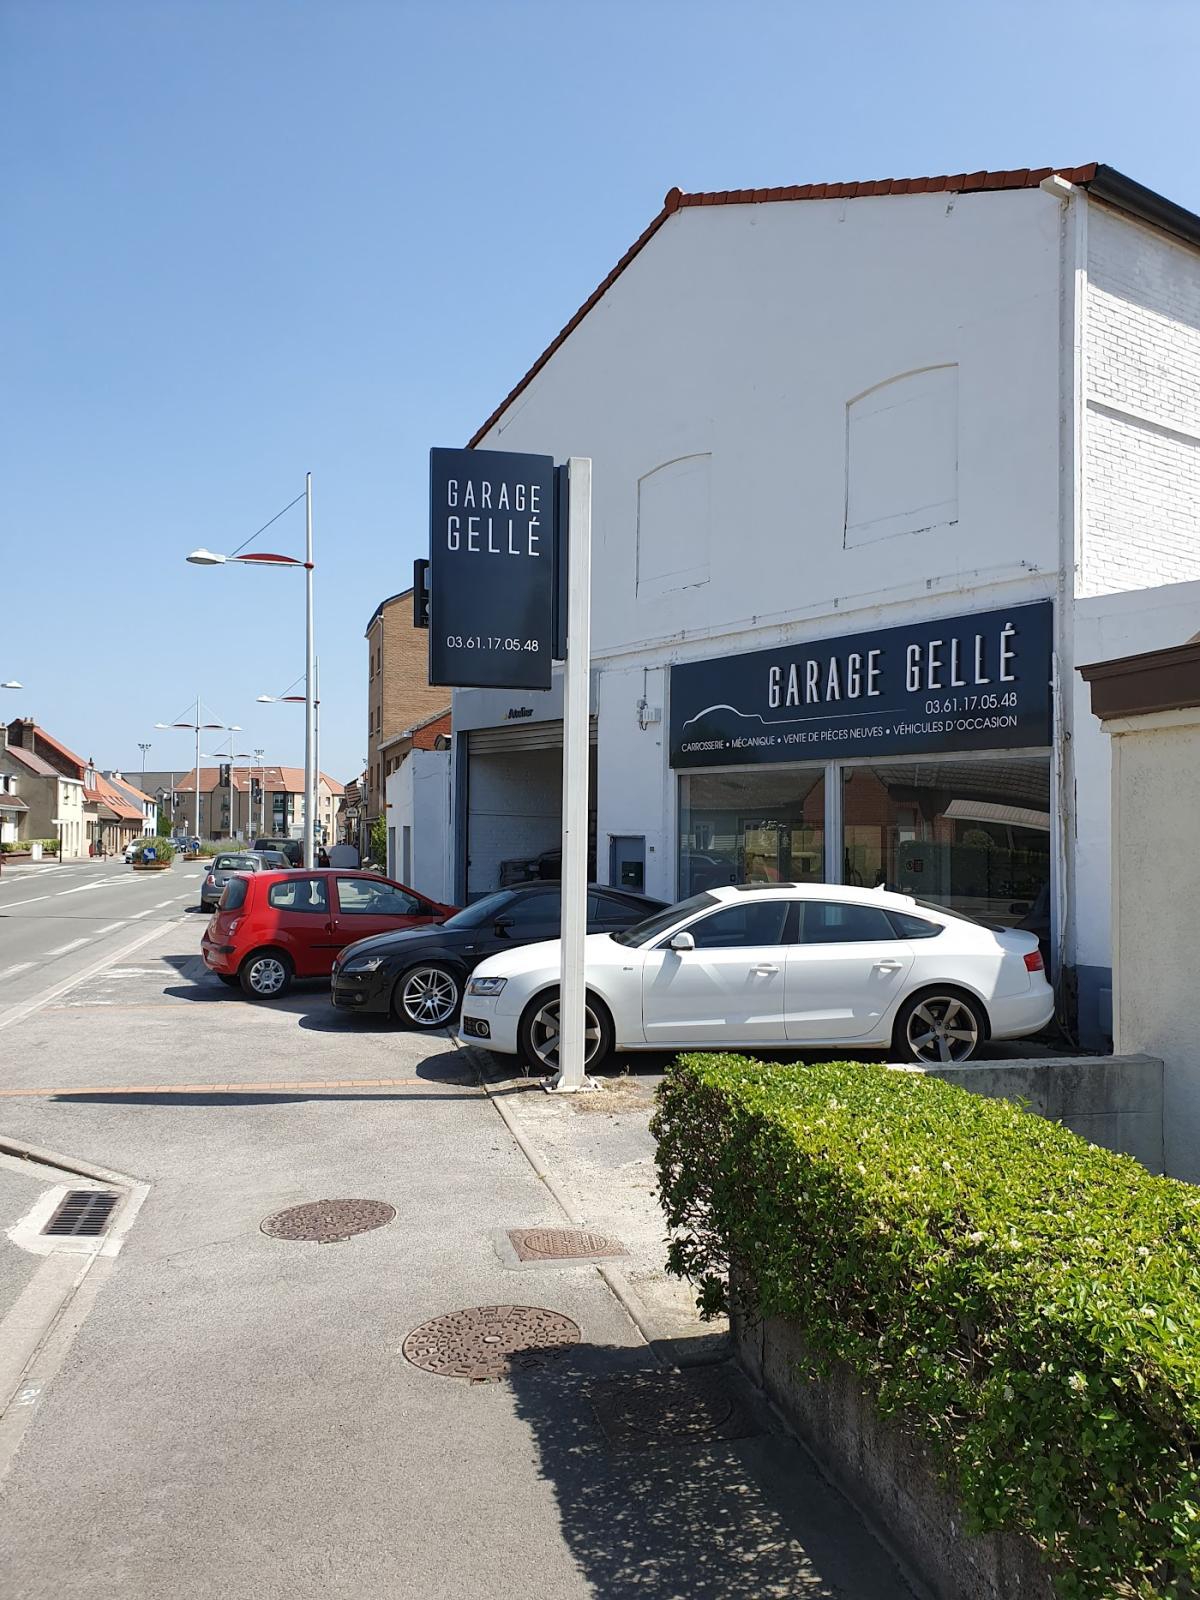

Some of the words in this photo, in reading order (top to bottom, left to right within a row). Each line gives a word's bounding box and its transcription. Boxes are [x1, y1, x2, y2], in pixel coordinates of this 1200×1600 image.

[448, 479, 541, 513] GARAGE
[447, 515, 540, 556] GELLÉ
[446, 635, 540, 652] 03.61.17.05.48
[768, 649, 882, 708] GARAGE
[906, 622, 1016, 692] GELLÉ
[508, 706, 534, 719] Atelier
[925, 692, 1018, 714] 03.61.17.05.48
[681, 739, 725, 752] CARROSSERIE
[731, 735, 775, 748] MÉCANIQUE
[783, 732, 807, 744] VENTE
[808, 731, 819, 742] DE
[820, 727, 848, 741] PIÈCES
[850, 726, 883, 739] NEUVES
[893, 721, 944, 735] VÉHICULES
